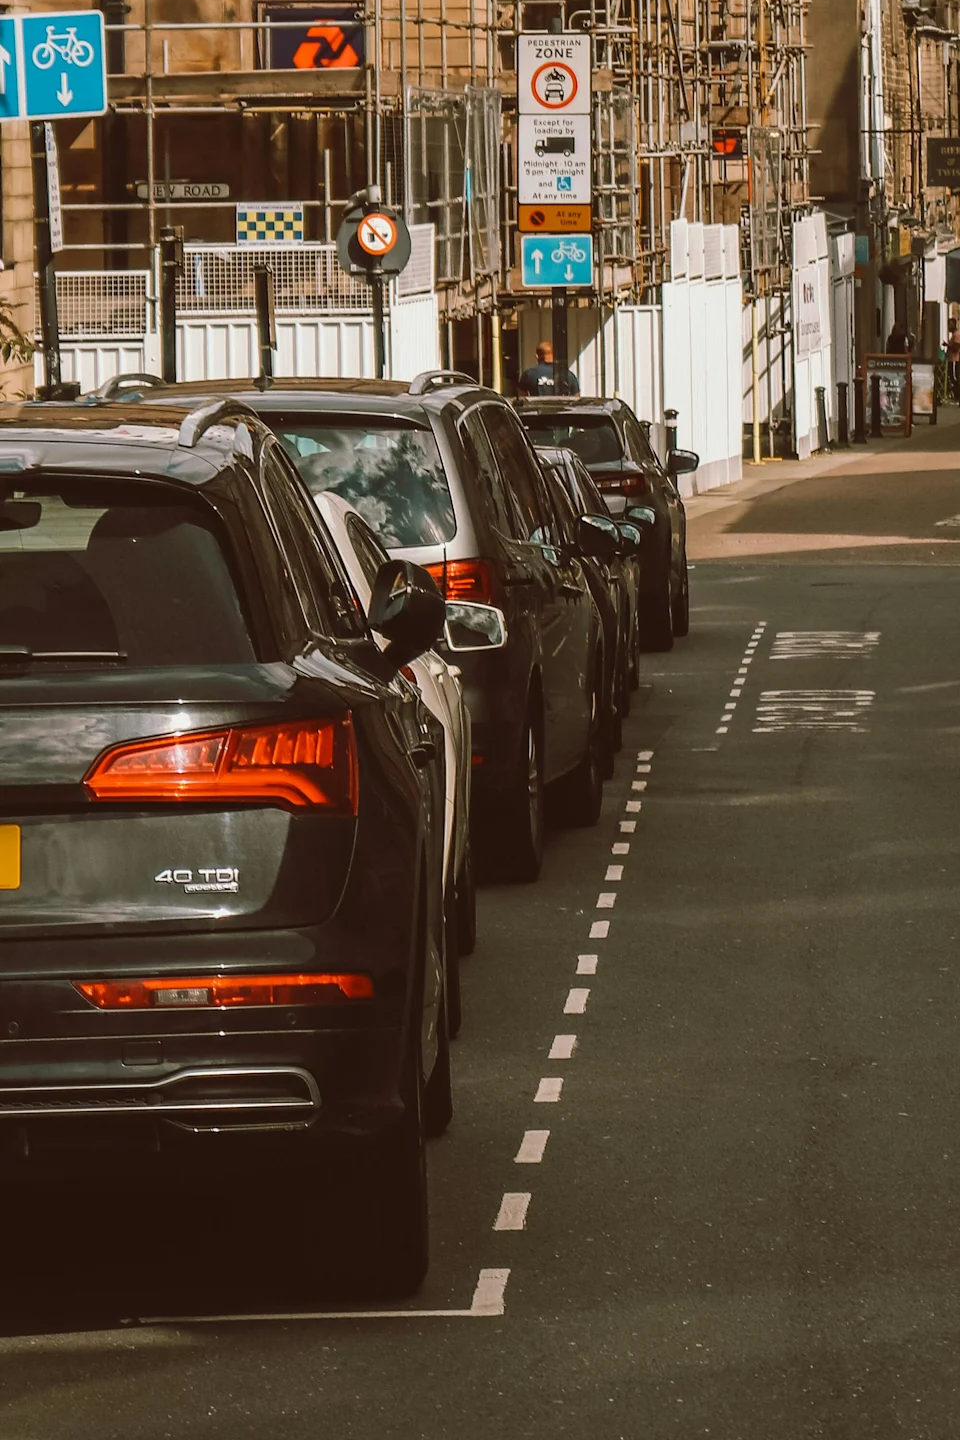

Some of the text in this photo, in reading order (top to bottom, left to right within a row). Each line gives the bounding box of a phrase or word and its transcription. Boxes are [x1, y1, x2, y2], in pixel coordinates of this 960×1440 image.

[535, 48, 573, 58] ZONE
[533, 119, 560, 127] Except
[534, 127, 575, 135] loading by
[184, 185, 220, 196] ROAD
[154, 867, 240, 883] 40 TDI
